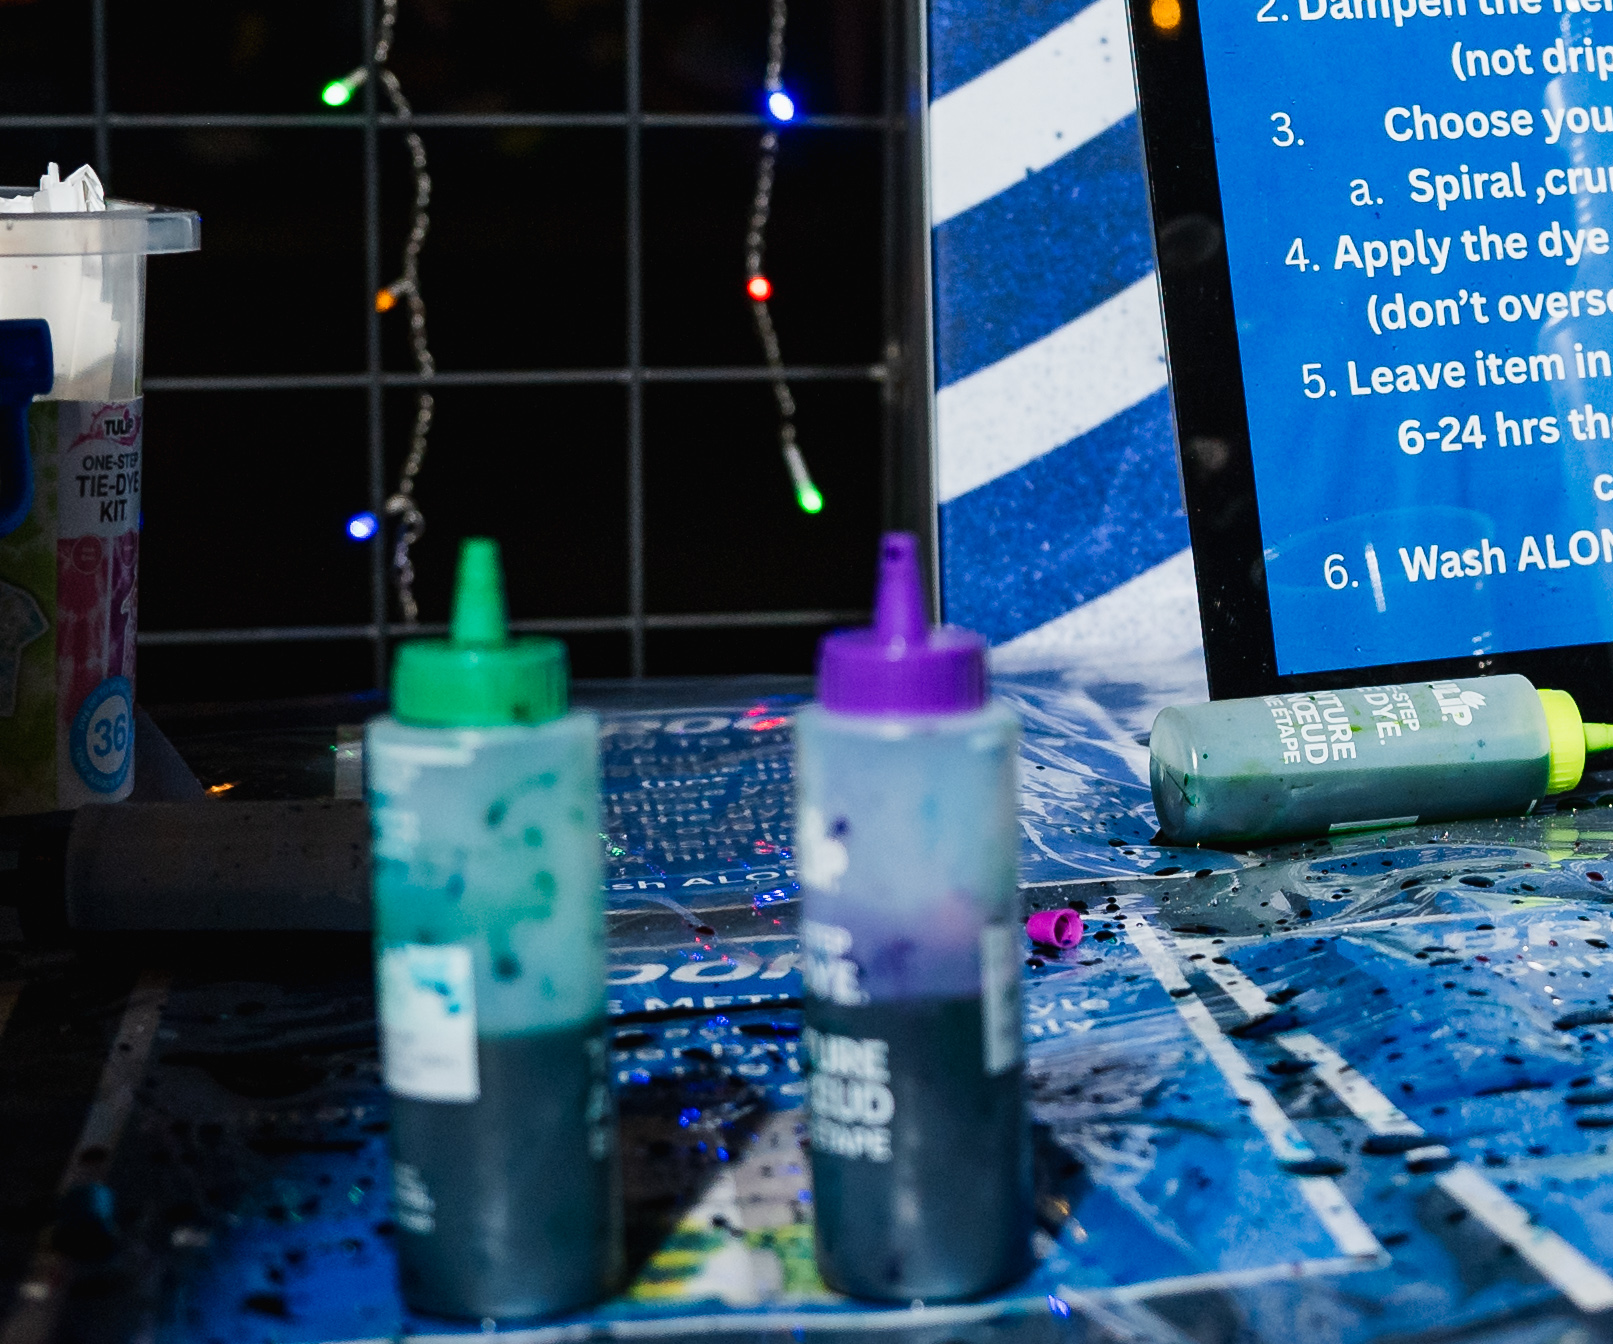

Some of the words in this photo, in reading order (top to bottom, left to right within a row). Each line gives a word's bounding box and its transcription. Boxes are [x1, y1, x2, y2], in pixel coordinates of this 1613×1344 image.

[1452, 42, 1533, 81] (not
[1271, 112, 1304, 146] 3.
[1385, 105, 1533, 141] Choose
[1350, 179, 1383, 206] a.
[1409, 162, 1526, 210] Spiral
[1285, 238, 1319, 271] 4.
[1335, 233, 1451, 277] Apply
[1461, 226, 1527, 261] the
[1538, 221, 1609, 265] dye
[1303, 364, 1336, 398] 5.
[1348, 361, 1465, 395] Leave
[1475, 350, 1565, 385] item
[1576, 346, 1611, 377] in
[104, 417, 134, 436] TULIP
[1399, 415, 1486, 454] 6-24
[1496, 412, 1560, 447] hrs
[82, 451, 138, 471] ONE-STEP
[76, 471, 139, 498] TIE-DYE
[1324, 554, 1358, 589] 6.
[1399, 539, 1506, 581] Wash
[93, 713, 126, 757] 36
[1363, 693, 1402, 746] DYE.
